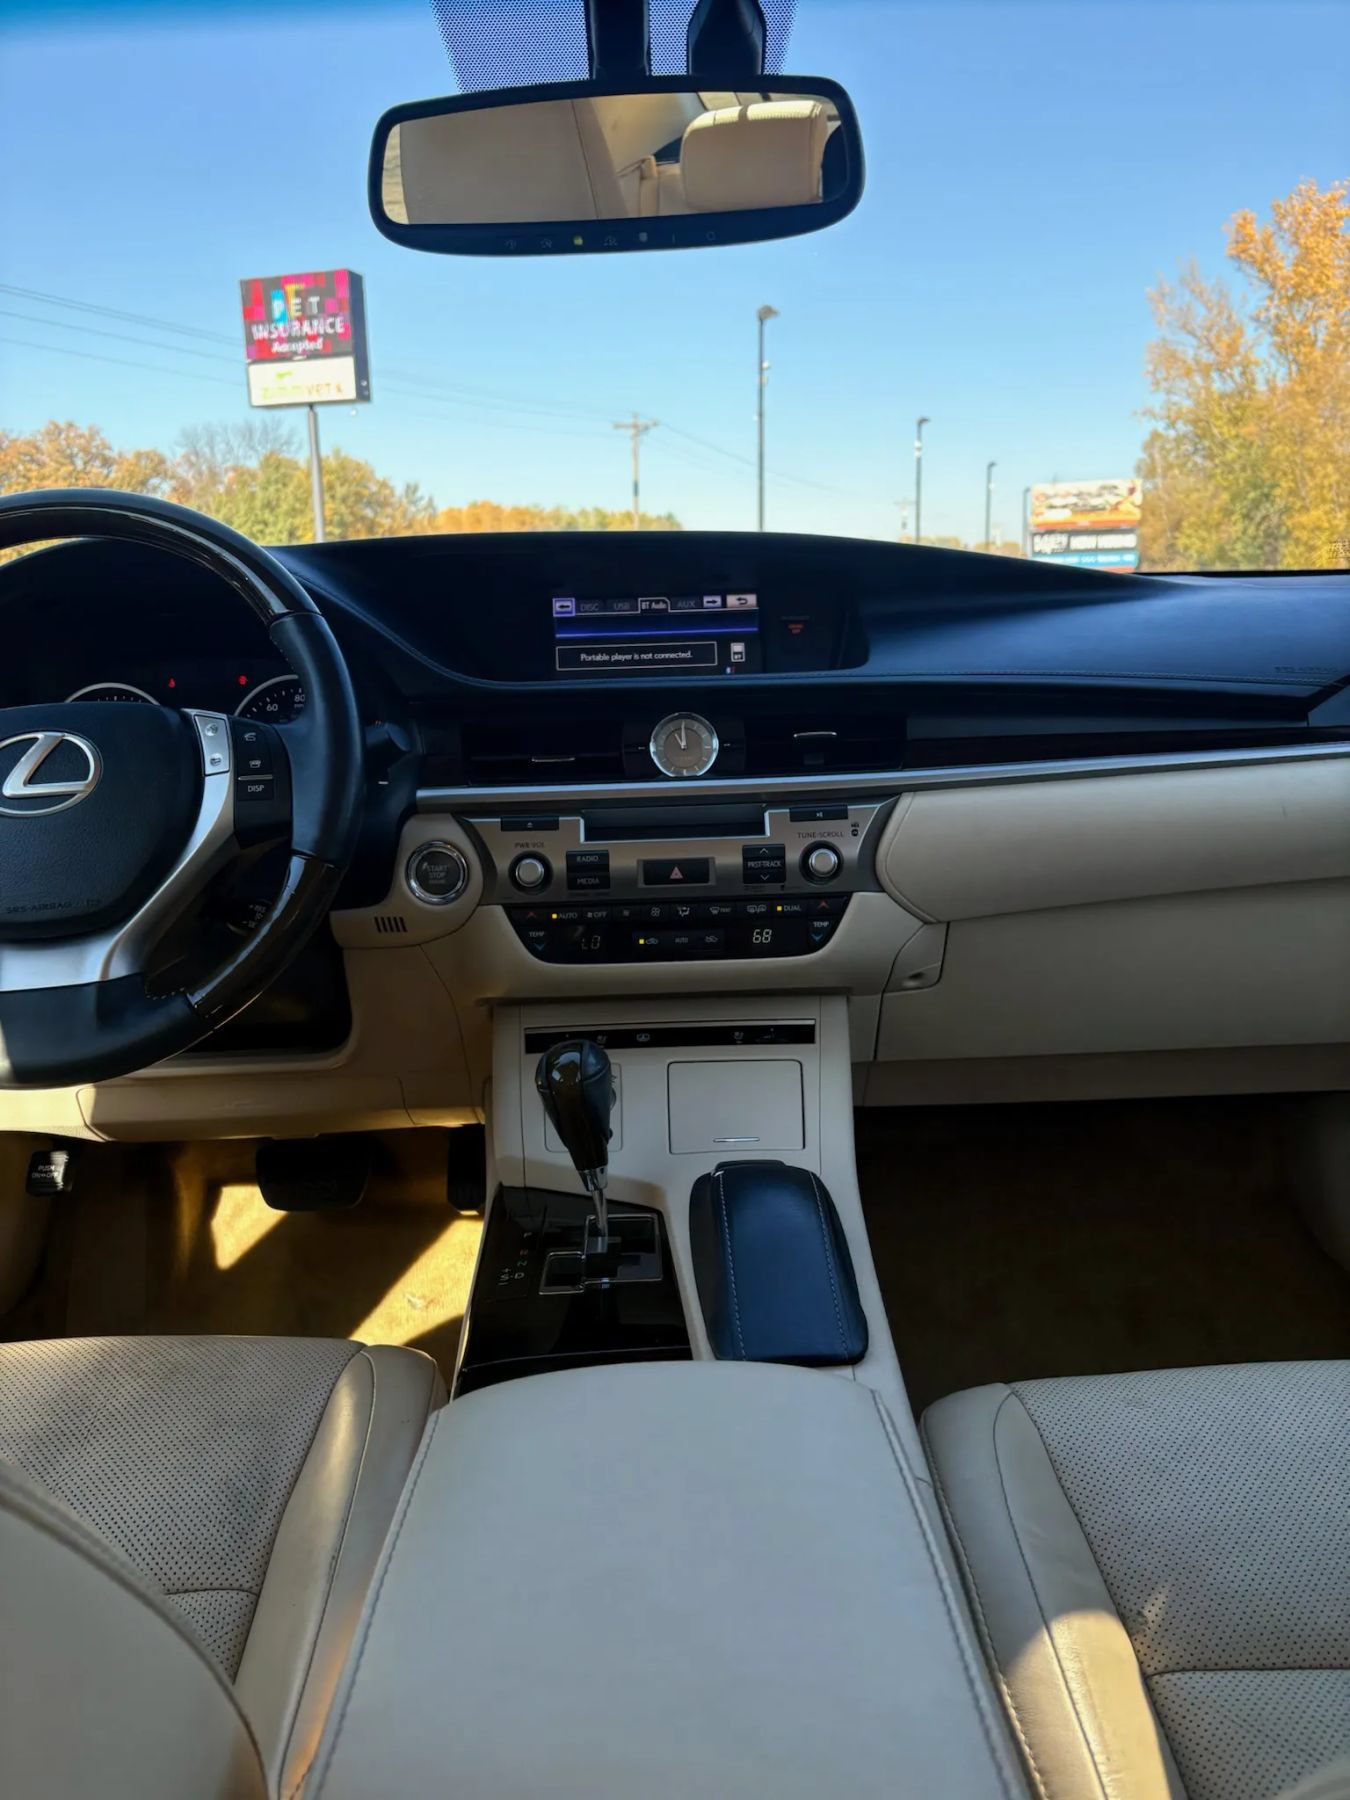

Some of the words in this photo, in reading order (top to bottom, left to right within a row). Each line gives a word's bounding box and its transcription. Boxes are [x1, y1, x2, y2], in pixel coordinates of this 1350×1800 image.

[251, 316, 345, 340] INSURANCE
[272, 337, 324, 355] Accepted
[580, 602, 600, 611] DISC
[641, 601, 650, 609] BT
[676, 599, 696, 608] AUX
[580, 652, 610, 662] Portable
[611, 652, 633, 662] player
[633, 652, 640, 661] is
[640, 652, 653, 660] not
[654, 650, 693, 659] connected.
[294, 694, 305, 702] 80
[266, 703, 278, 712] 60
[247, 784, 264, 793] DISP
[576, 877, 600, 885] MEDIA
[558, 911, 578, 919] AUTO
[528, 930, 545, 938] TEMP
[752, 928, 773, 944] 68
